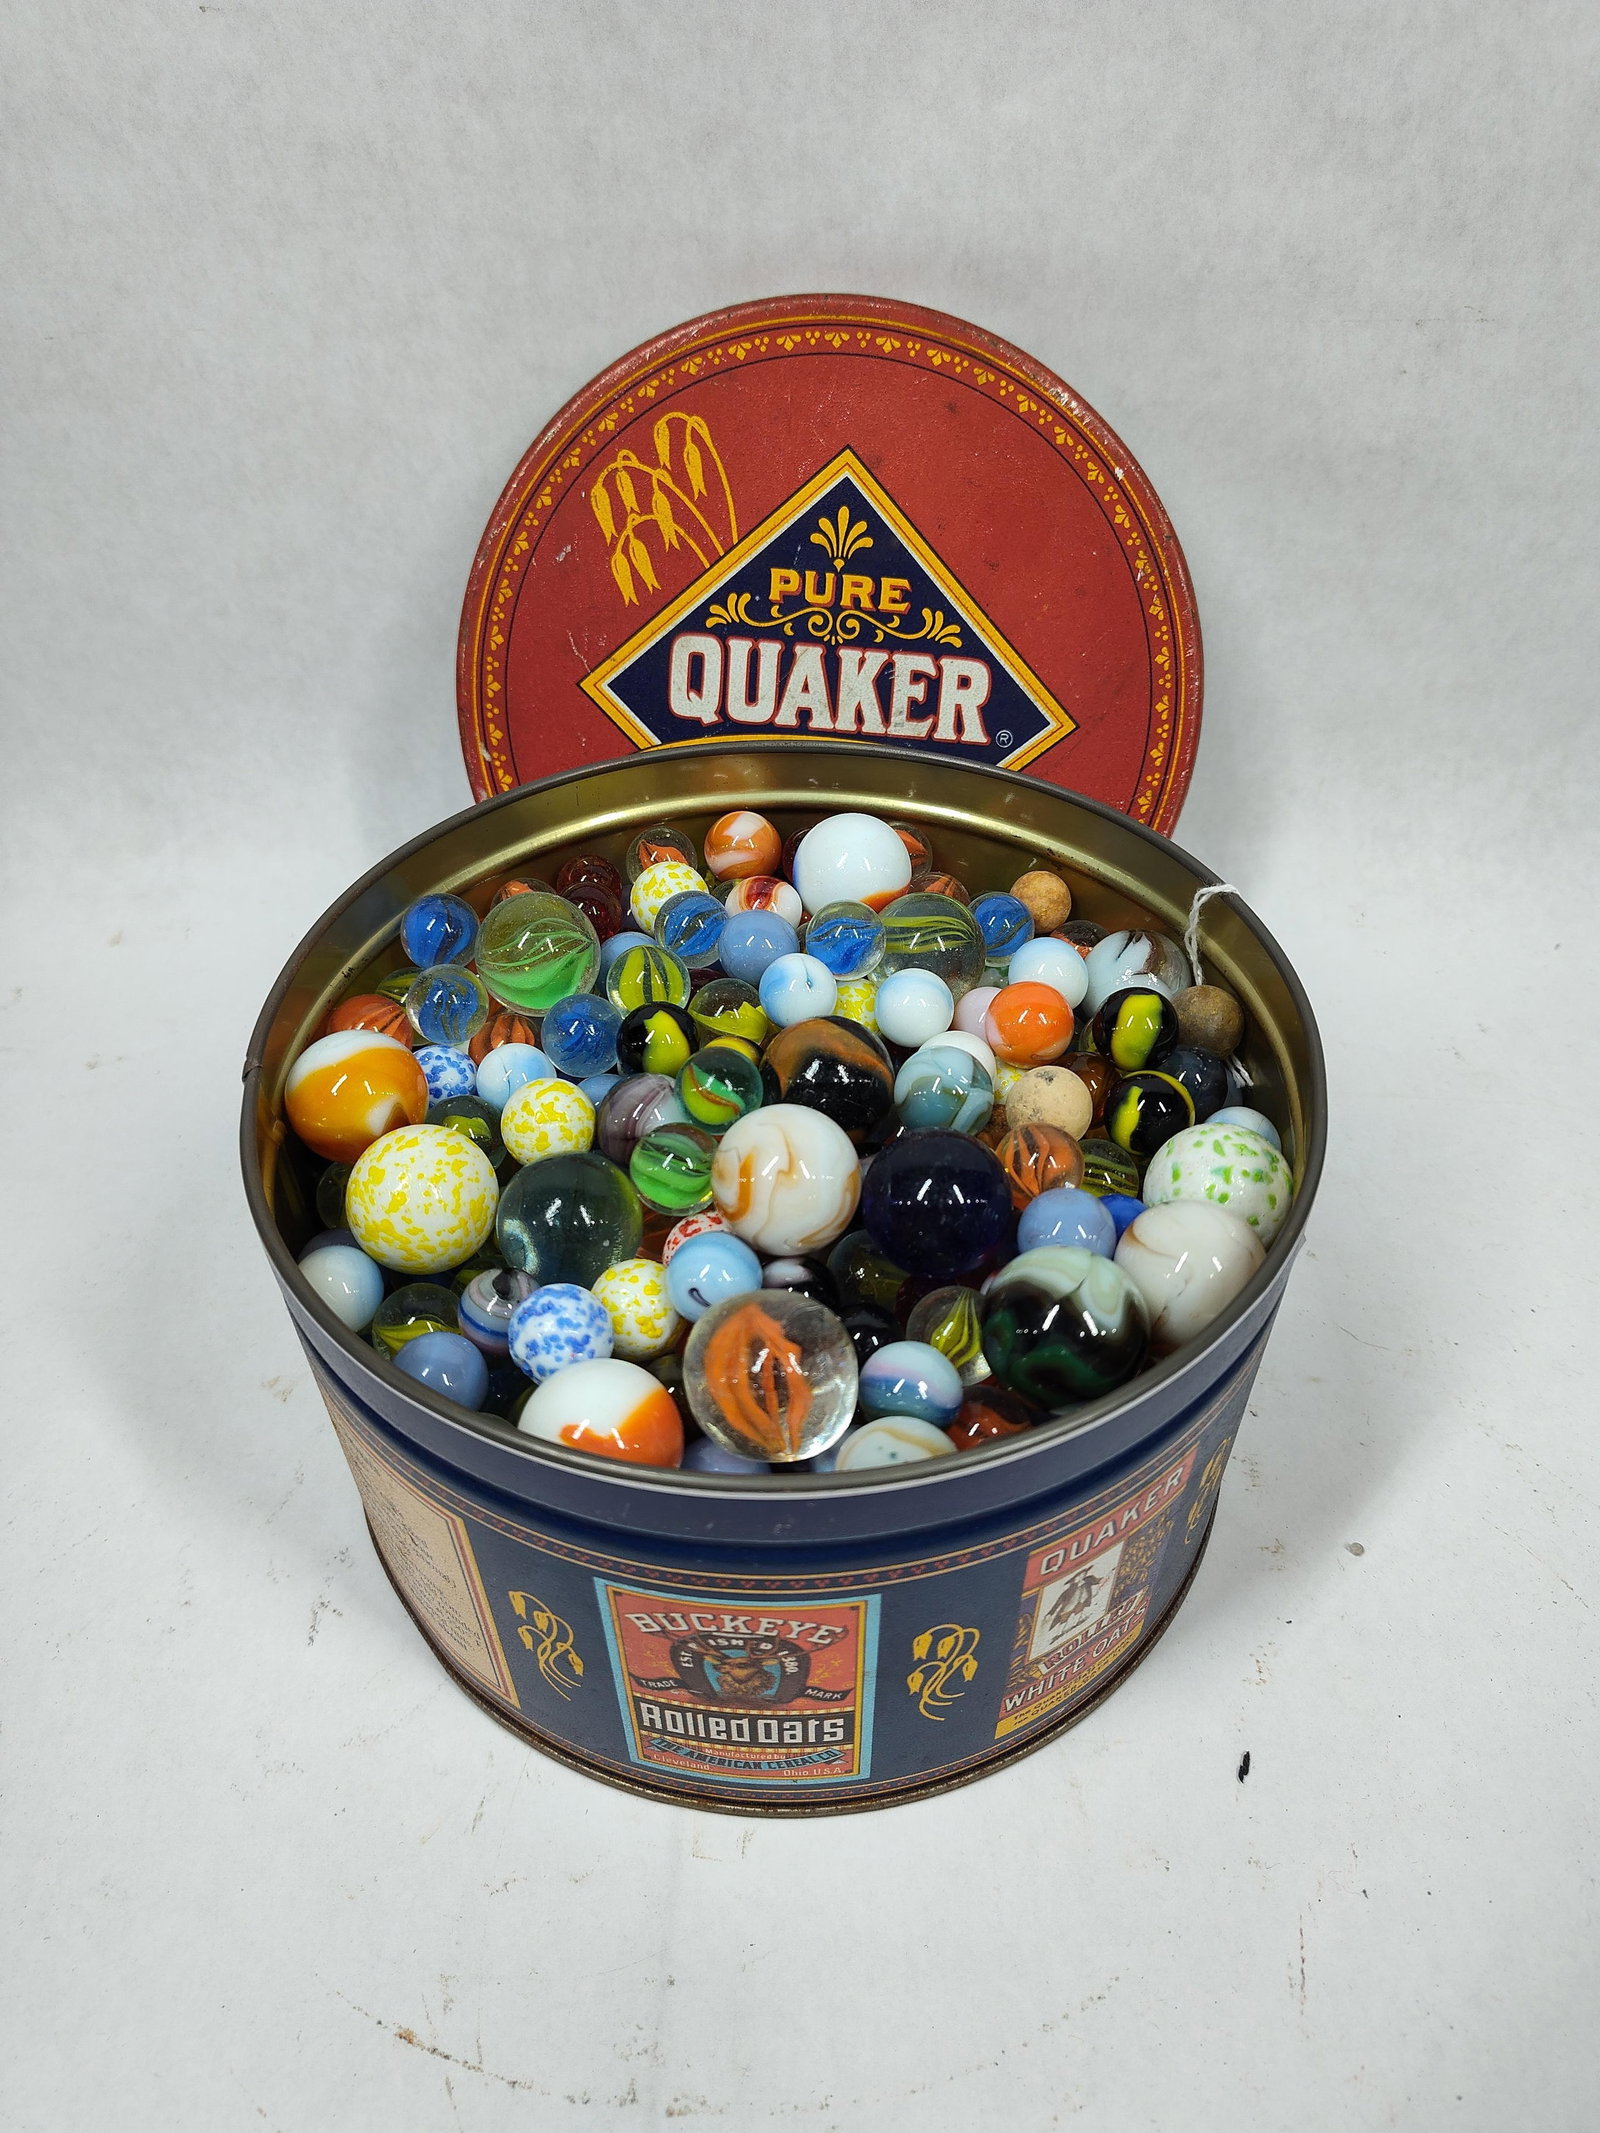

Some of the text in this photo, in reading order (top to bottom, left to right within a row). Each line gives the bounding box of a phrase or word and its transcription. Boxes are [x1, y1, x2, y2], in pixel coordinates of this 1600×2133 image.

[769, 567, 912, 614] PURE
[668, 632, 992, 746] QUAKER
[1039, 1466, 1184, 1576] QUAKER
[625, 1612, 847, 1646] BUCKEYE
[1004, 1652, 1088, 1713] WHITE
[1093, 1601, 1147, 1657] OATS
[641, 1678, 843, 1701] TRADE MARK
[639, 1702, 845, 1744] Rolled Oats
[688, 1750, 763, 1770] AMERICAN
[768, 1754, 821, 1770] CEREAL
[705, 1748, 773, 1760] Manufactured
